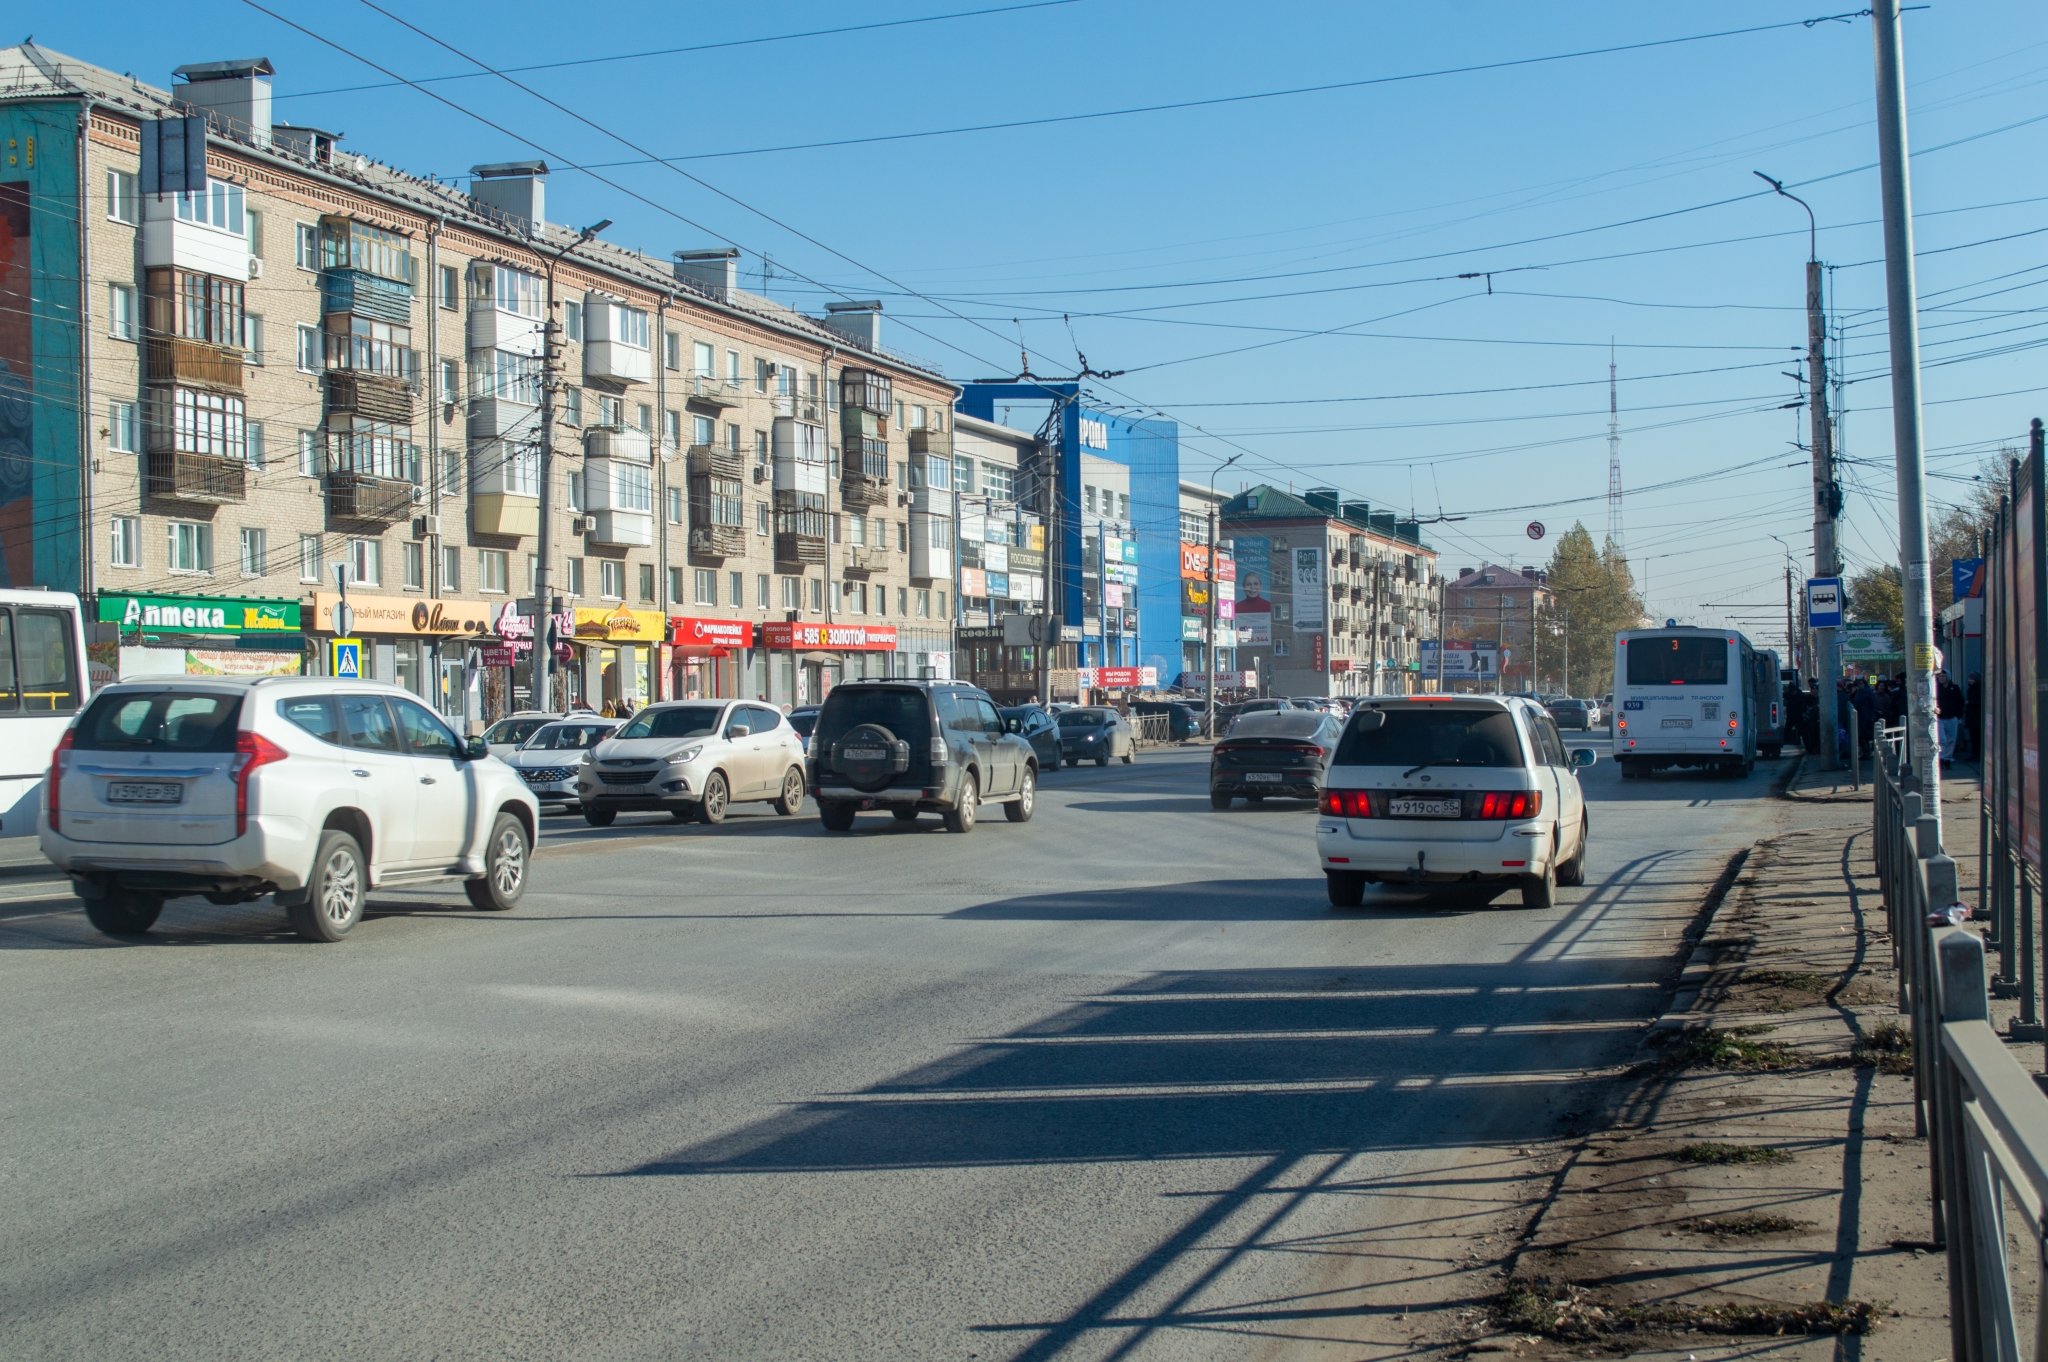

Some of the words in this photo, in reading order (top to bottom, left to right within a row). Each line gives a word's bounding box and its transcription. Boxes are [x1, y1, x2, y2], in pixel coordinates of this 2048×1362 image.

[1184, 551, 1200, 571] DNS
[123, 598, 225, 629] Аптека
[373, 608, 406, 620] МАГАЗИН
[562, 611, 573, 627] 24
[774, 635, 791, 643] 585
[804, 628, 819, 645] 585
[828, 628, 866, 645] ЗОЛОТОЙ
[867, 632, 896, 643] ГИПЕРМАРКЕТ
[1671, 639, 1678, 650] 3
[484, 649, 511, 657] ЦВЕТЫ
[1395, 802, 1440, 814] У919ОС
[1443, 802, 1455, 811] 55
